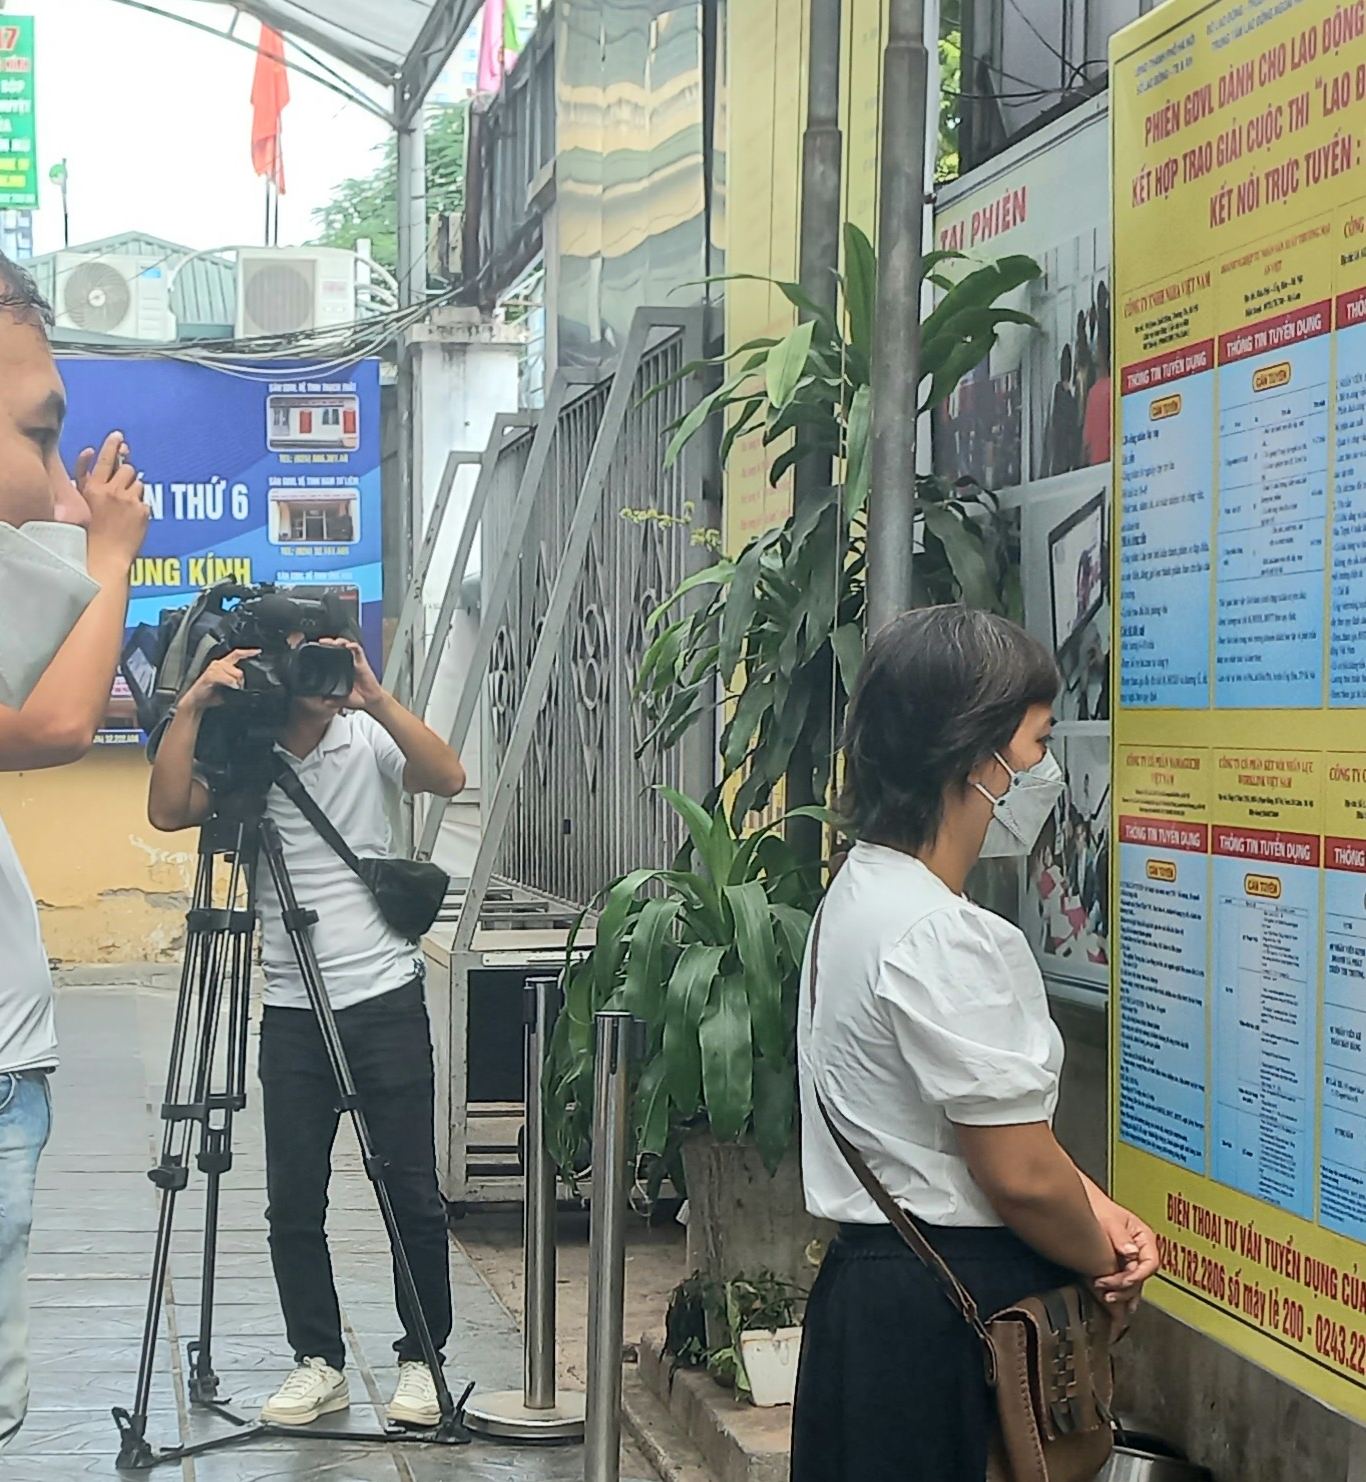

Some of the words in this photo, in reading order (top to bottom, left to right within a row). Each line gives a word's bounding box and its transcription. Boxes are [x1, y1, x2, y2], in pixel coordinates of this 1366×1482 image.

[1145, 99, 1180, 148] PHIÊN
[1184, 83, 1214, 128] GDVL
[1218, 64, 1254, 109] DÀNH
[1259, 42, 1285, 88] CHO
[1290, 25, 1317, 72] LAO
[1322, 0, 1364, 56] ĐỘNG
[1132, 164, 1151, 208] KẾT
[1155, 156, 1179, 199] HỢP
[1183, 140, 1213, 184] TRAO
[1217, 118, 1242, 168] GIẢI
[1246, 103, 1283, 153] CUỘC
[1288, 92, 1309, 133] THI
[970, 185, 1028, 247] PHIÊN
[1209, 180, 1233, 228] KẾT
[1237, 165, 1259, 216] NỐI
[1265, 159, 1299, 205] TRỰC
[171, 475, 227, 520] THỨ
[232, 484, 248, 520] 6
[189, 552, 251, 586] KÍNH
[1166, 1192, 1190, 1232] ĐIỆN
[1192, 1205, 1221, 1249] THOẠI
[1224, 1218, 1239, 1251] TƯ
[1240, 1220, 1261, 1263] VẤN
[1264, 1235, 1301, 1284] TUYỂN
[1304, 1255, 1337, 1299] DỤNG
[1228, 1268, 1241, 1309] số
[1243, 1281, 1266, 1326] máy
[1269, 1287, 1279, 1329] lẻ
[1282, 1298, 1304, 1343] 200
